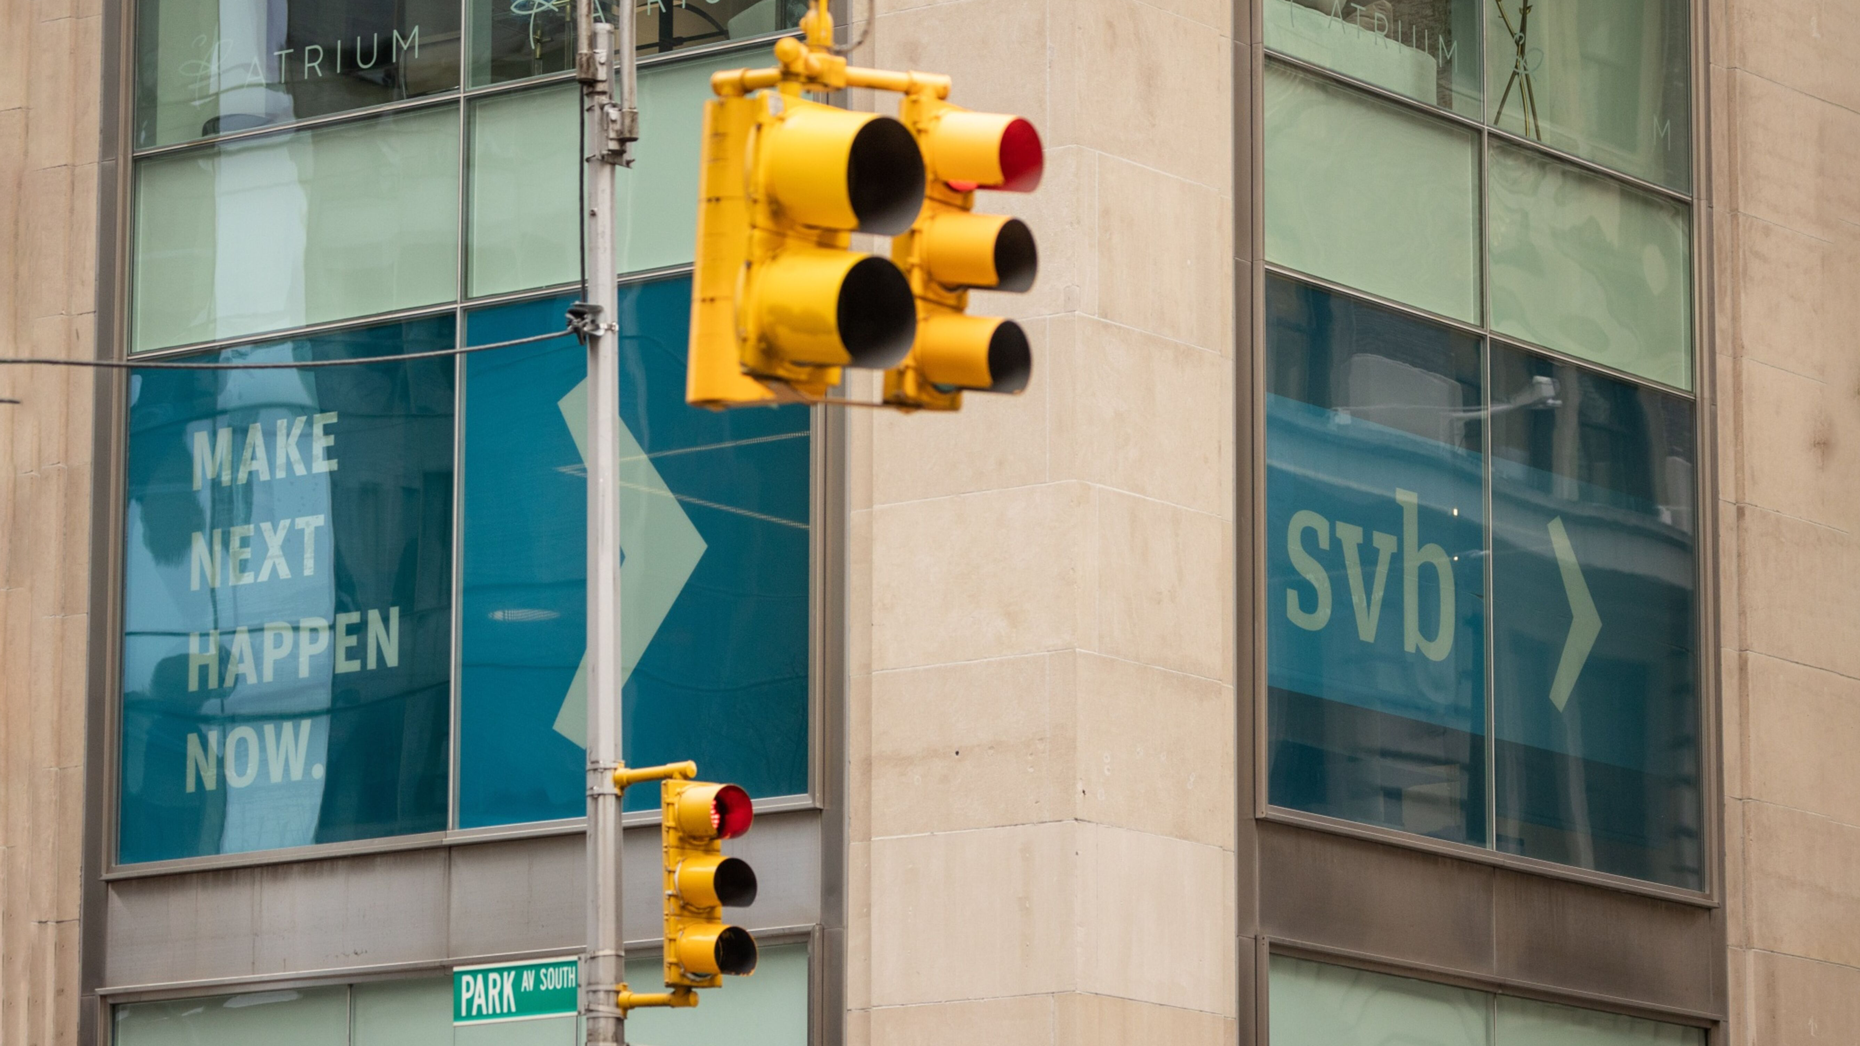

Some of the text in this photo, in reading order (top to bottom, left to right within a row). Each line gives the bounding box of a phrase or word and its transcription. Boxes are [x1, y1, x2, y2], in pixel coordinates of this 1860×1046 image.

[244, 24, 420, 90] ATRIUM
[192, 411, 338, 491] MAKE
[190, 514, 325, 592] NEXT
[1286, 487, 1456, 662] svb
[188, 606, 400, 692] HAPPEN
[186, 719, 325, 793] NOW.
[461, 966, 576, 1017] PARK AV SOUTH
